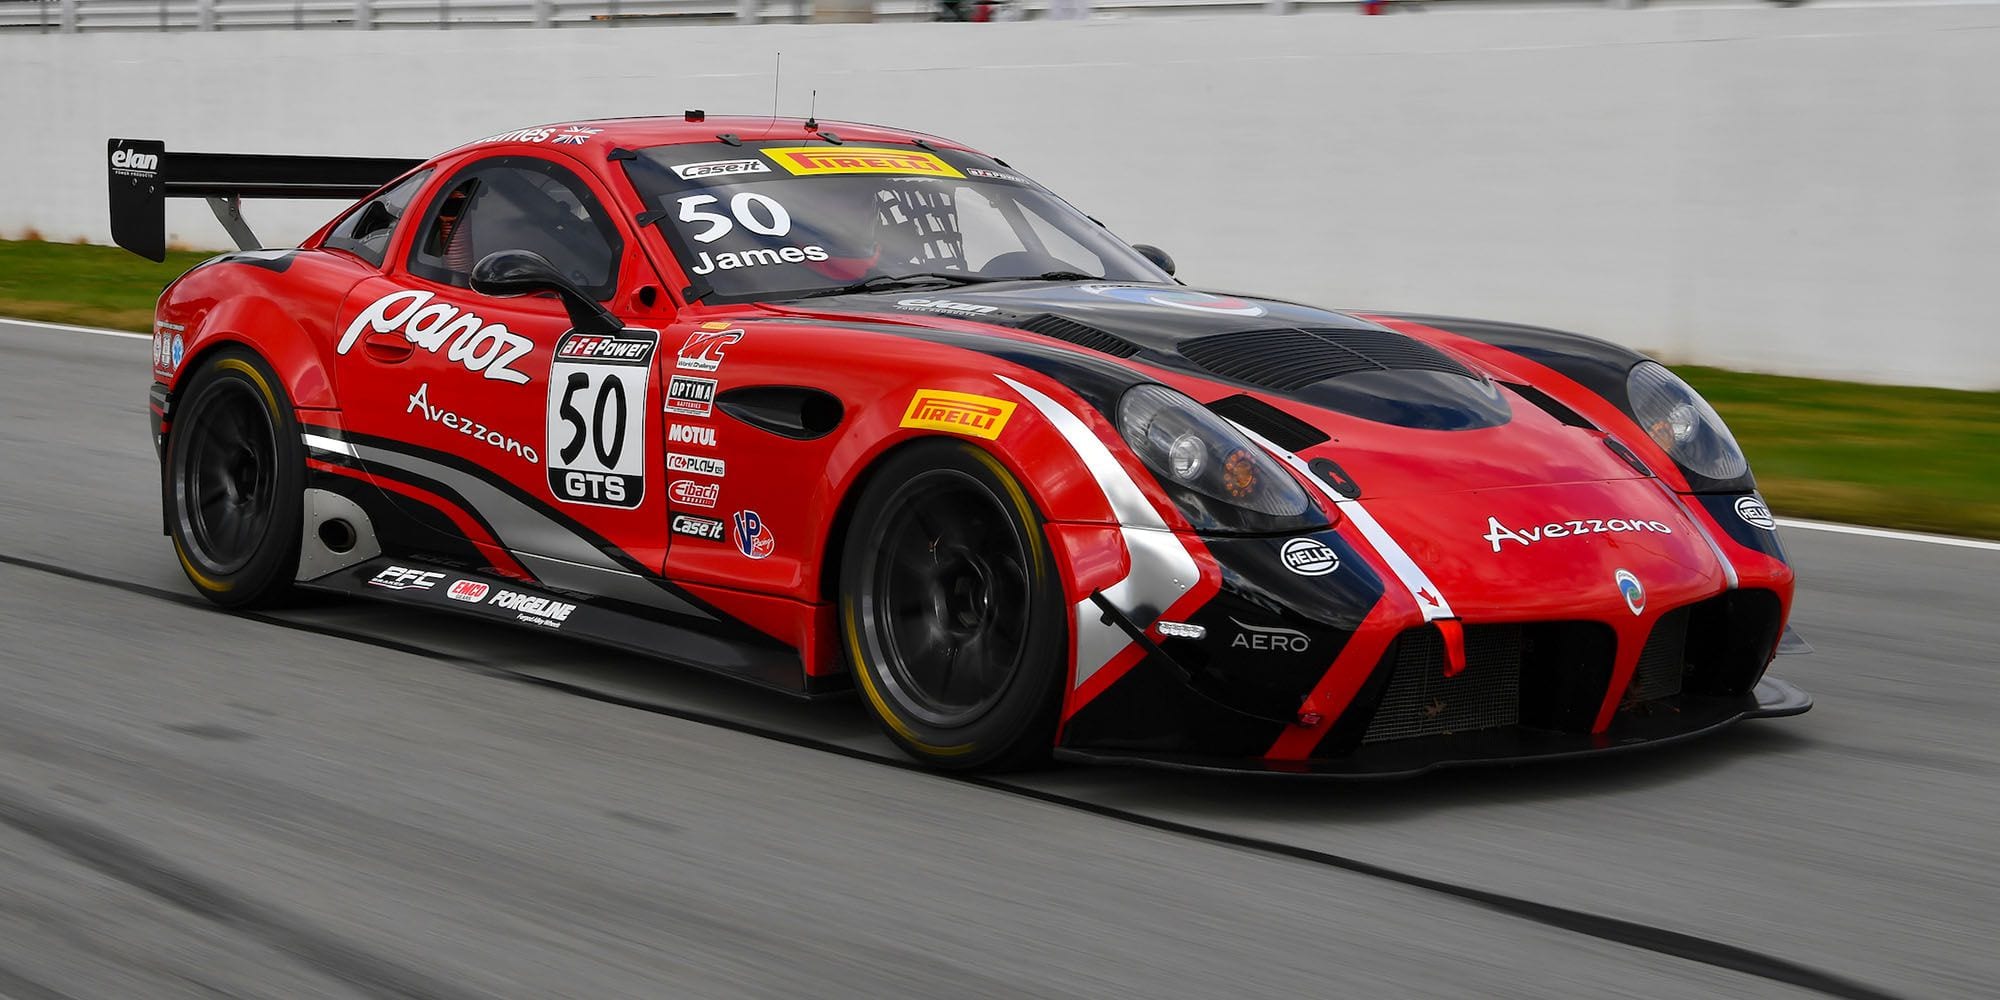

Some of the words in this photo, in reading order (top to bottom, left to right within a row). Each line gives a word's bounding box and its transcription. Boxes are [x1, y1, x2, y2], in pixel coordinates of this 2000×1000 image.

[785, 152, 943, 172] PIRELLI
[677, 192, 791, 243] 50
[691, 245, 829, 275] James
[671, 381, 712, 400] OPTIMA
[406, 383, 539, 463] Avezzano
[559, 372, 627, 470] 50
[910, 397, 1002, 430] PIRELLI
[668, 424, 717, 446] MOTUL
[565, 471, 626, 501] GTS
[734, 510, 761, 557] VP
[1482, 516, 1672, 552] Avezzano
[1286, 547, 1339, 567] HELLA
[376, 566, 447, 587] PFC
[451, 581, 488, 597] EMCO
[487, 589, 577, 621] FORGELINE
[1231, 632, 1309, 652] AERO
